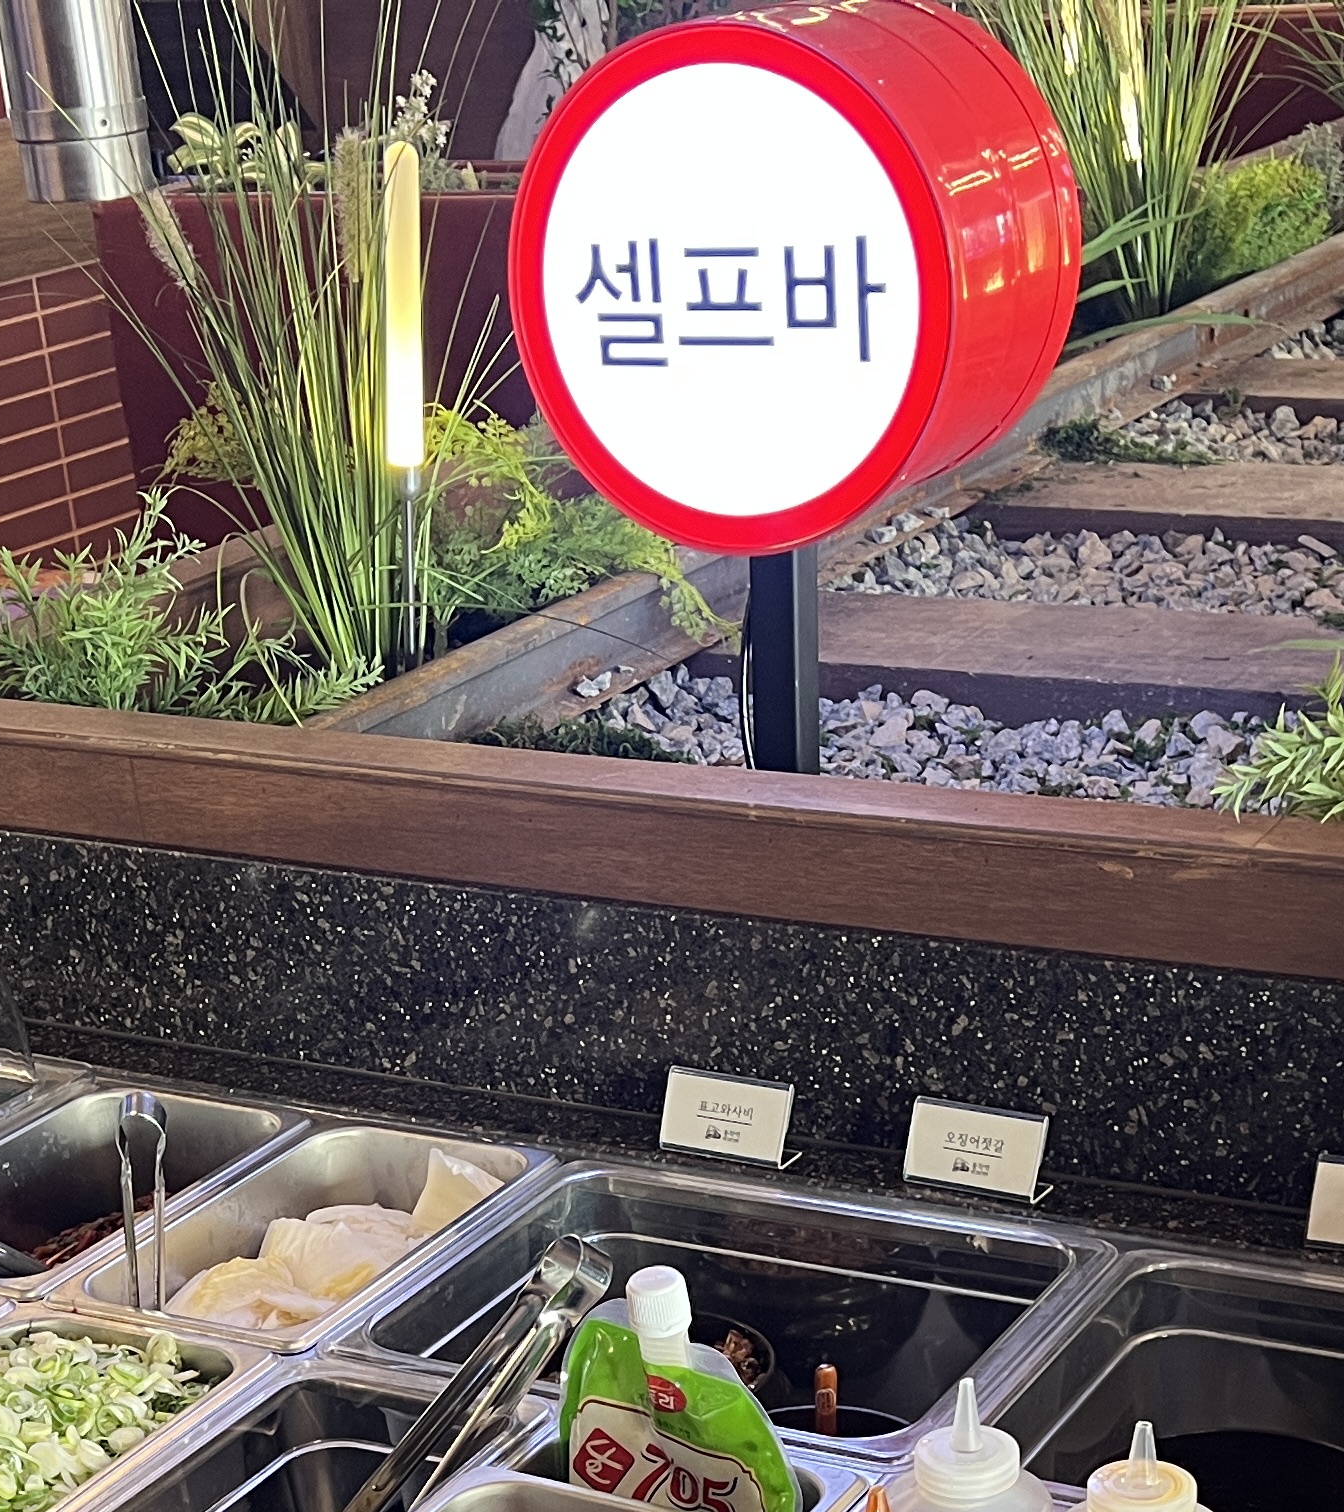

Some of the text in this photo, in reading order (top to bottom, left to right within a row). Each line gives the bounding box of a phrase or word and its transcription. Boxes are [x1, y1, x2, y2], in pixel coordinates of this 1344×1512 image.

[575, 235, 887, 367] 셀프바
[697, 1100, 754, 1121] 표고와사비
[944, 1131, 1005, 1153] 오징어젓갈
